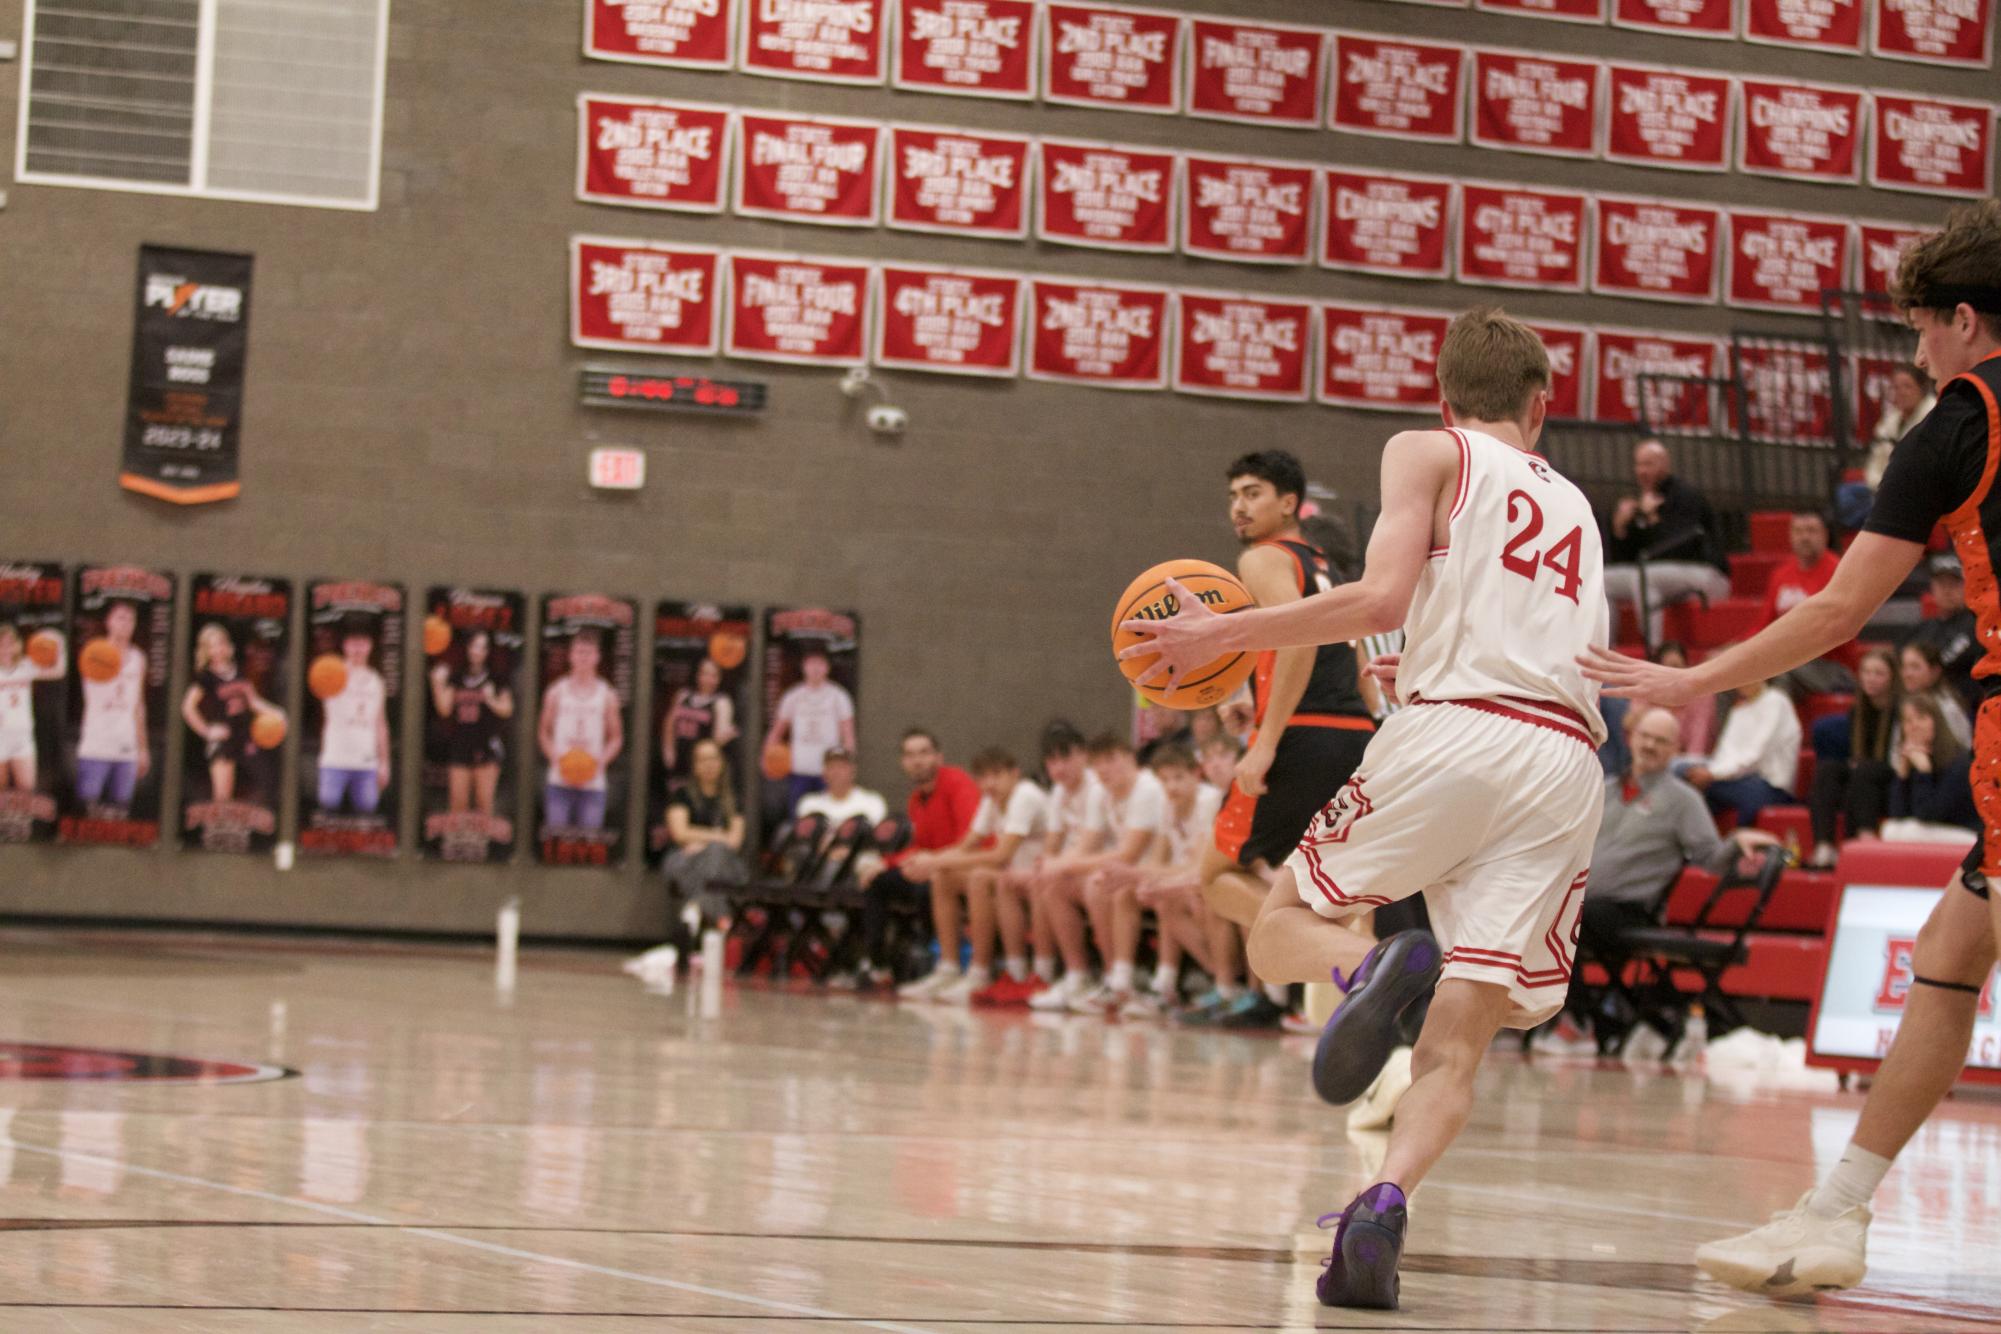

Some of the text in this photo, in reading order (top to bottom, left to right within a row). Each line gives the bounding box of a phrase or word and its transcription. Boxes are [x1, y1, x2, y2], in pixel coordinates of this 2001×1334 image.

[910, 7, 1021, 48] 3RD PLACE
[1057, 21, 1167, 63] 2ND PLACE
[1202, 36, 1311, 79] FINAL FOUR
[1346, 52, 1450, 95] 2ND PLACE
[1485, 67, 1589, 110] FINAL FOUR
[1619, 82, 1718, 124] 2ND PLACE
[597, 116, 712, 160] 2ND PLACE
[752, 132, 867, 174] FINAL FOUR
[904, 146, 1014, 189] 3RD PLACE
[1052, 161, 1162, 203] 2ND PLACE
[1198, 175, 1302, 215] 3RD PLACE
[1474, 204, 1576, 244] 4TH PLACE
[1741, 230, 1838, 269] 4TH PLACE
[589, 261, 704, 303] 3RD PLACE
[742, 273, 856, 316] FINAL FOUR
[894, 286, 1004, 326] 4TH PLACE
[1044, 297, 1153, 338] 2ND PLACE
[1192, 311, 1298, 352] 2ND PLACE
[1333, 325, 1435, 363] 4TH PLACE
[1499, 488, 1583, 606] 24
